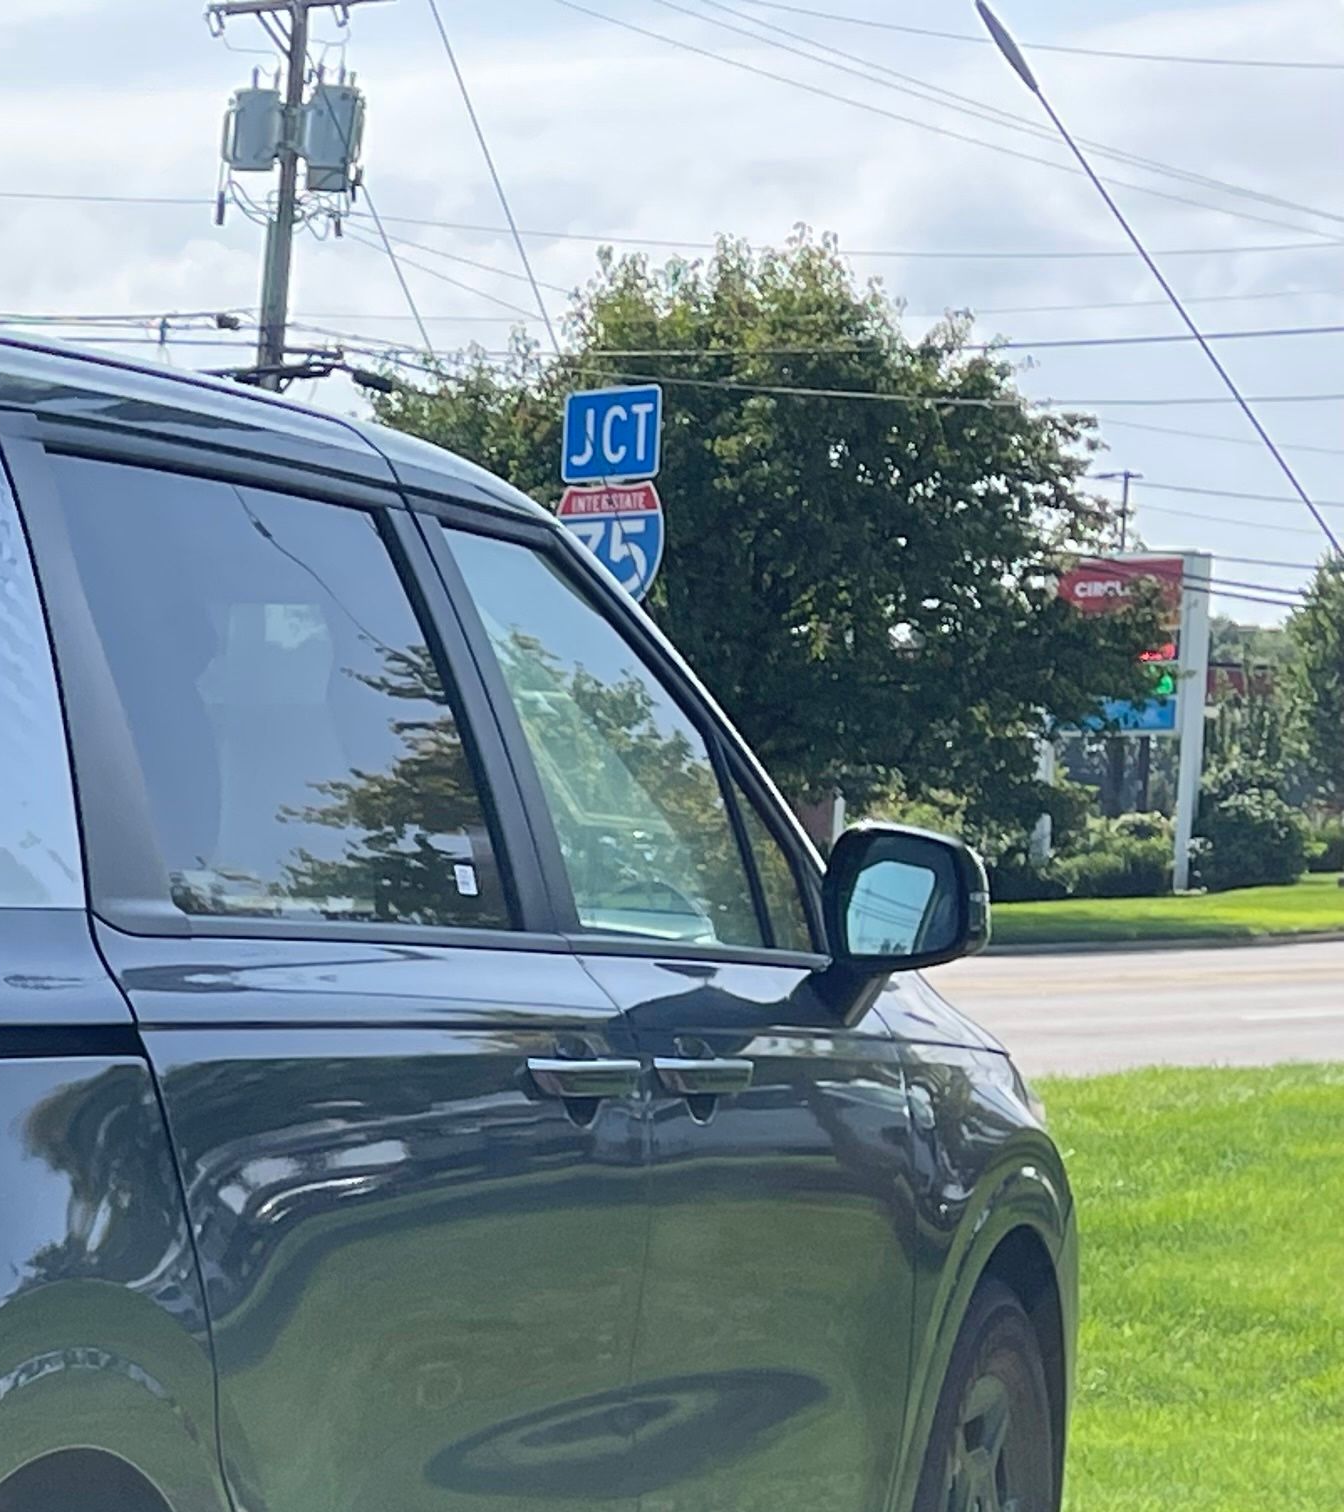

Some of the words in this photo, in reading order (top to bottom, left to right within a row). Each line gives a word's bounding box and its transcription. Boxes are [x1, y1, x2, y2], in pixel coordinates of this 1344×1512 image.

[569, 402, 654, 467] JCT
[570, 491, 647, 513] INTERSTATE
[1074, 580, 1131, 598] CIRCL
